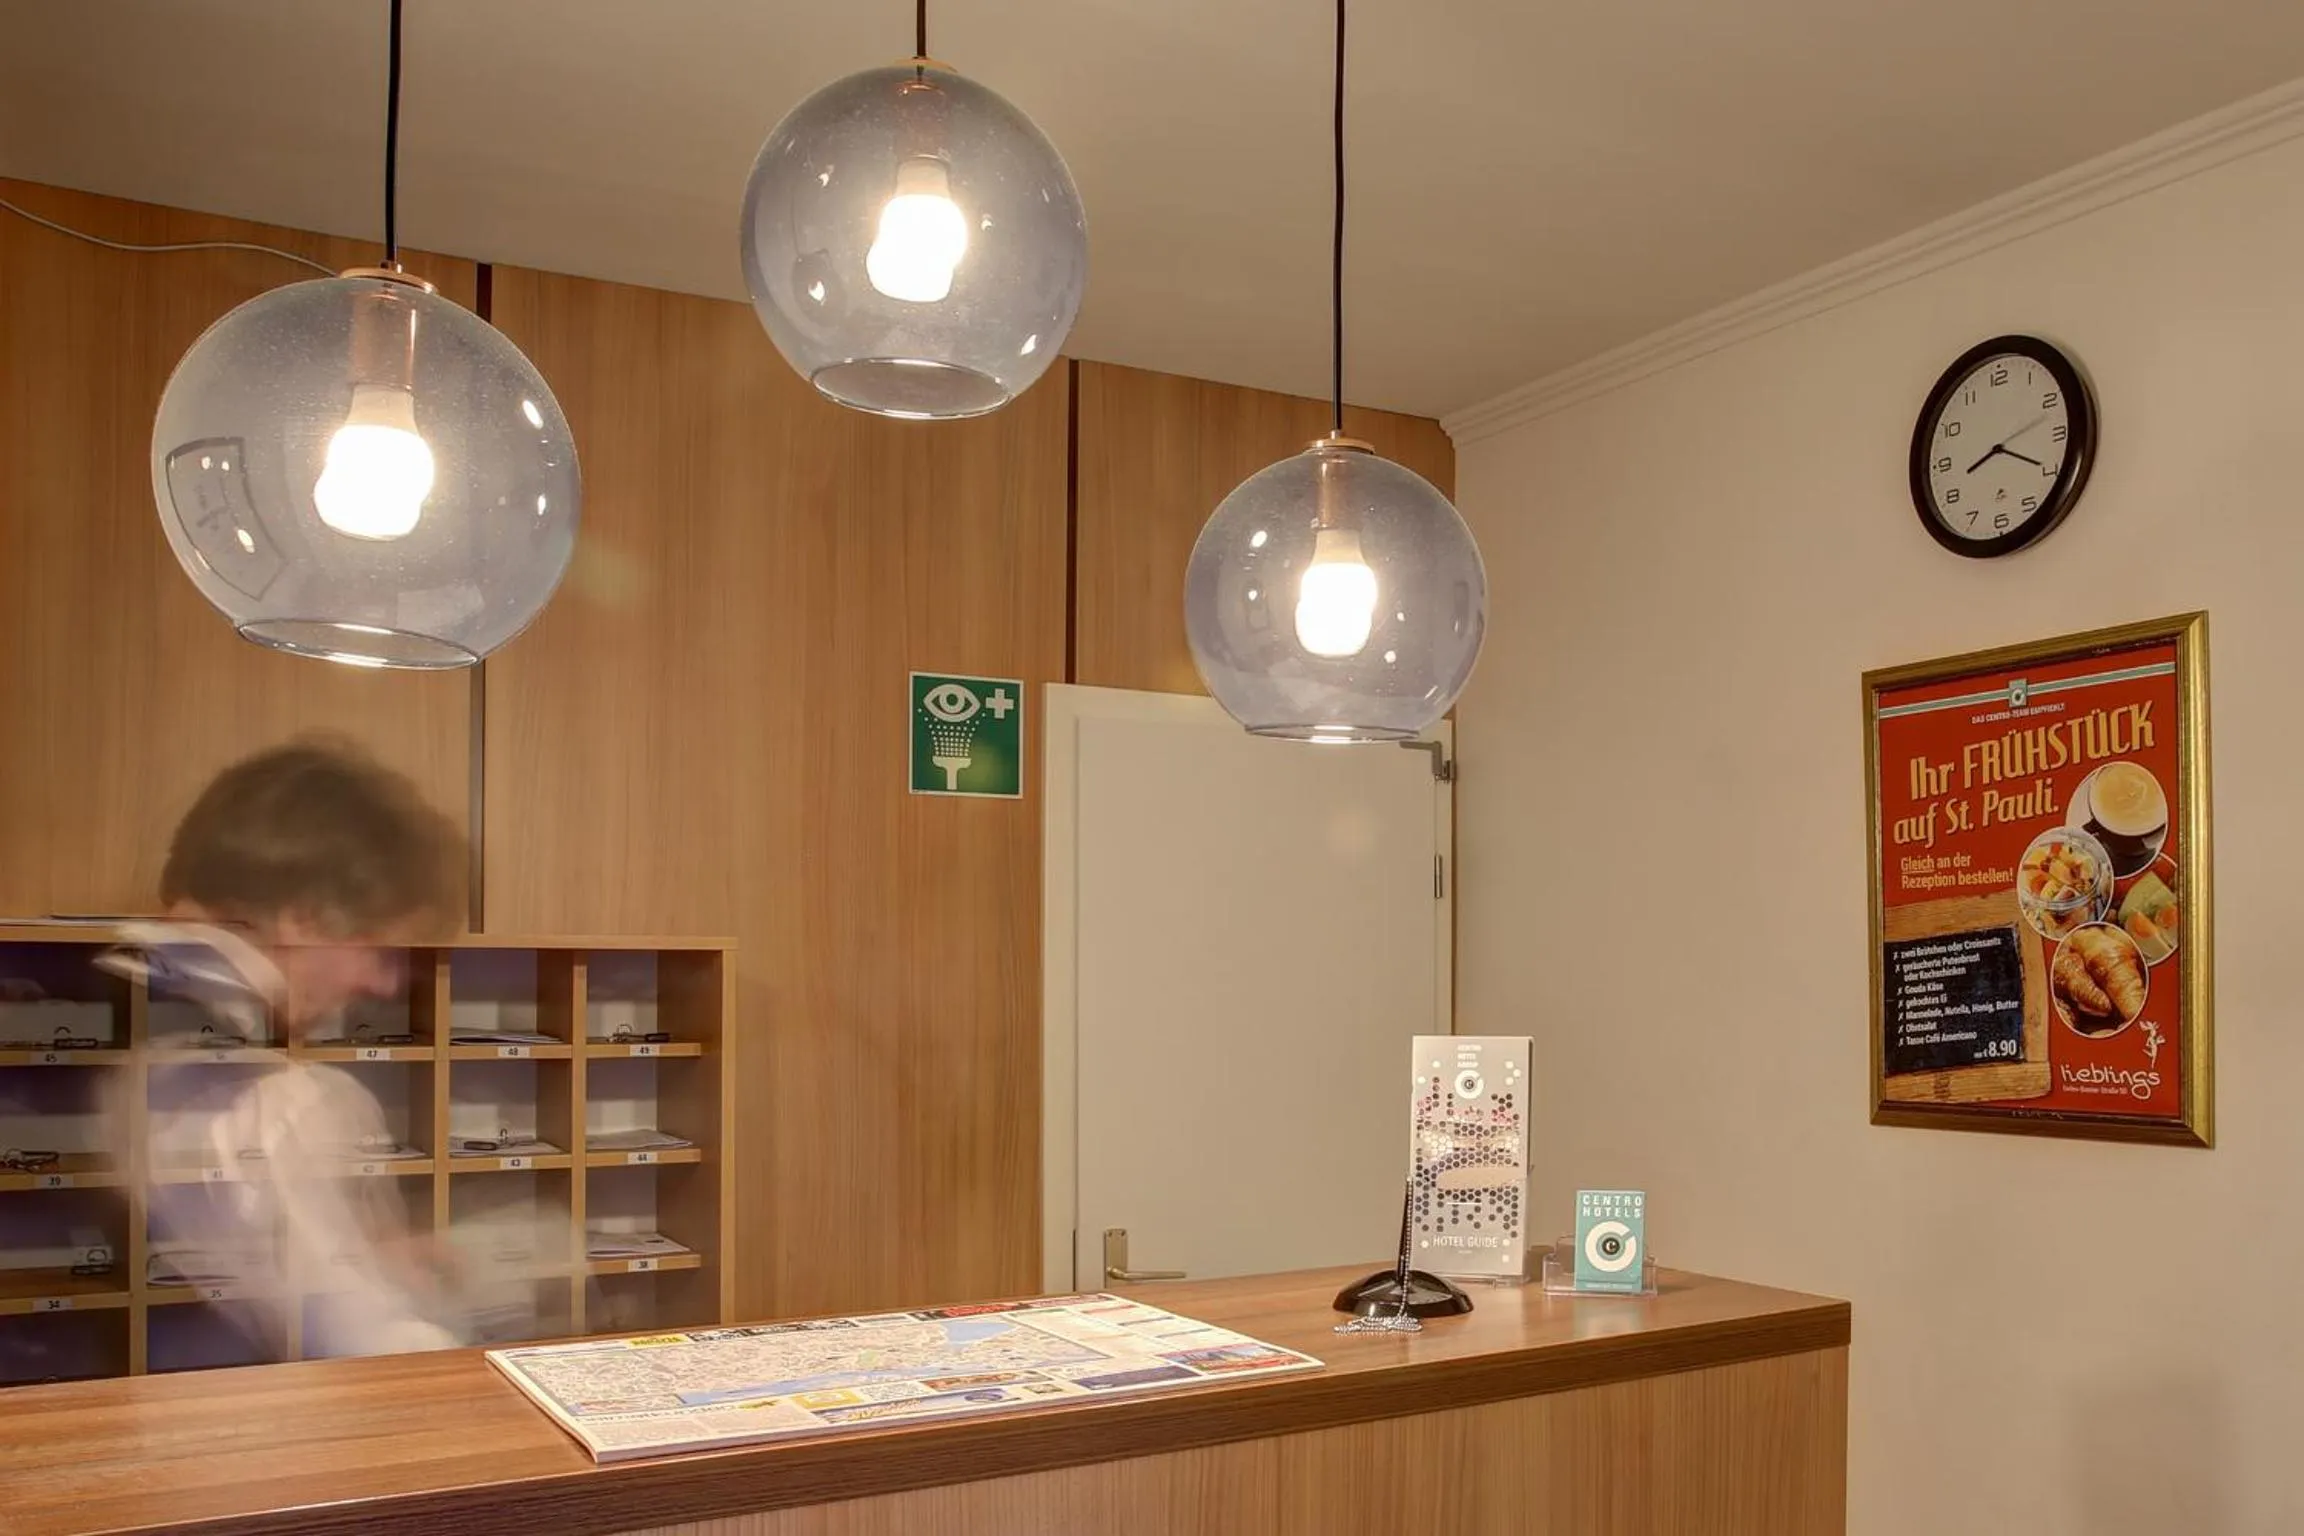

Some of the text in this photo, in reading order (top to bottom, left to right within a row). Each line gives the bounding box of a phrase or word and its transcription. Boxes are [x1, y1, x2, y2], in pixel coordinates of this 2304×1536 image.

[1990, 369, 2008, 387] 12
[1966, 391, 1976, 406] 11
[2042, 392, 2057, 409] 2
[1942, 422, 1961, 438] 10
[2052, 425, 2066, 443] 3
[1938, 457, 1951, 472] 9
[2042, 464, 2058, 476] 4
[1946, 488, 1960, 504] 8
[2021, 496, 2037, 512] 5
[1966, 511, 1979, 526] 7
[1994, 514, 2009, 529] 6
[1910, 701, 2155, 800] Ihr FRÜHSTÜCK
[1893, 778, 2059, 848] auf St. Pauli.
[1901, 852, 1971, 873] Gleich an der
[1902, 867, 2014, 891] Rezeption bestellen!
[1988, 1039, 2017, 1057] 8.90
[2061, 1062, 2160, 1099] lieblings
[1583, 1195, 1642, 1206] CENTRO
[1583, 1207, 1641, 1218] HOTELS
[1433, 1235, 1498, 1248] HOTEL GUIDE
